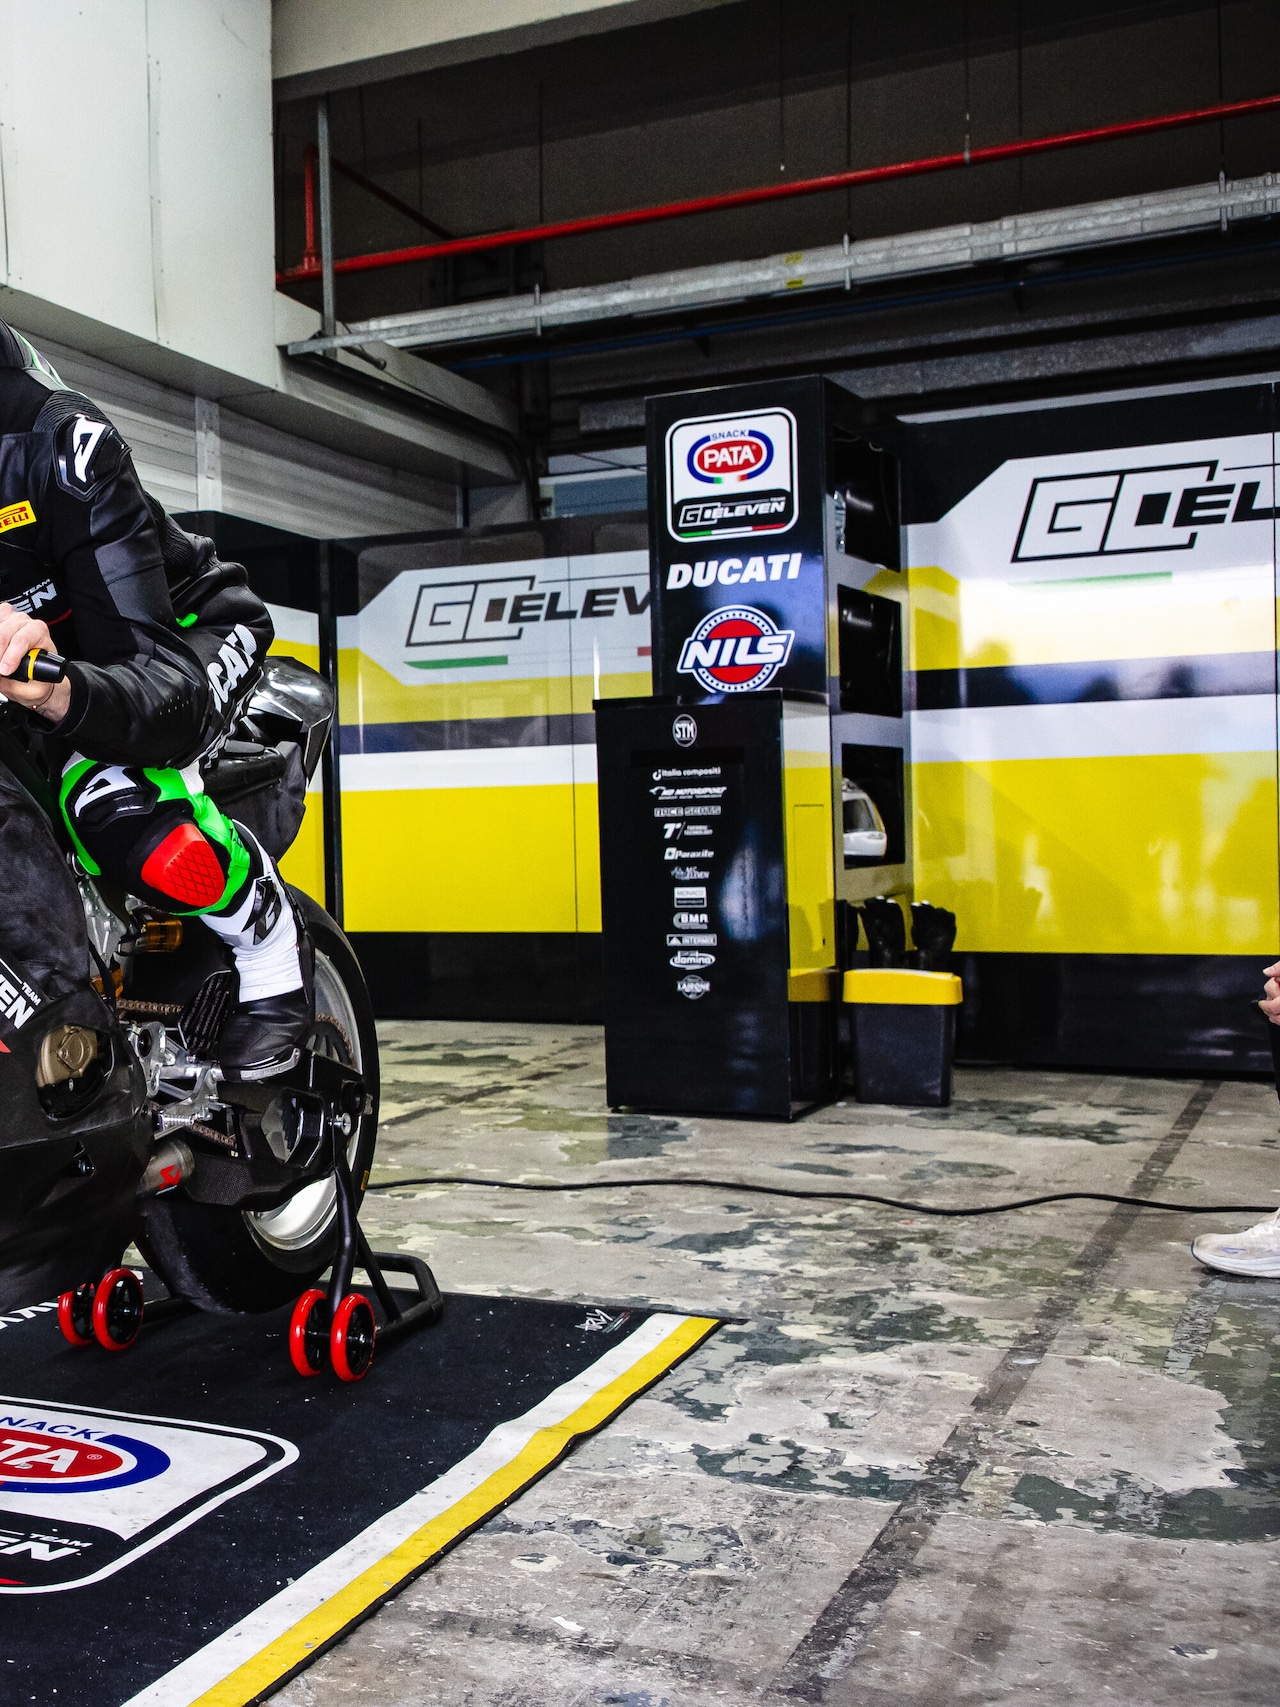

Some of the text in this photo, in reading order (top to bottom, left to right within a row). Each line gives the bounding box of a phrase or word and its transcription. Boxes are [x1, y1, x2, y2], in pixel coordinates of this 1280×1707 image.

[710, 429, 748, 441] SNACK
[703, 444, 756, 470] PATA
[666, 552, 803, 591] DUCATI
[405, 575, 652, 648] GOELEV
[682, 634, 788, 670] NILS
[674, 722, 695, 739] STM
[673, 950, 712, 965] domino
[21, 981, 41, 1007] TEAM
[28, 1533, 94, 1549] TEAM
